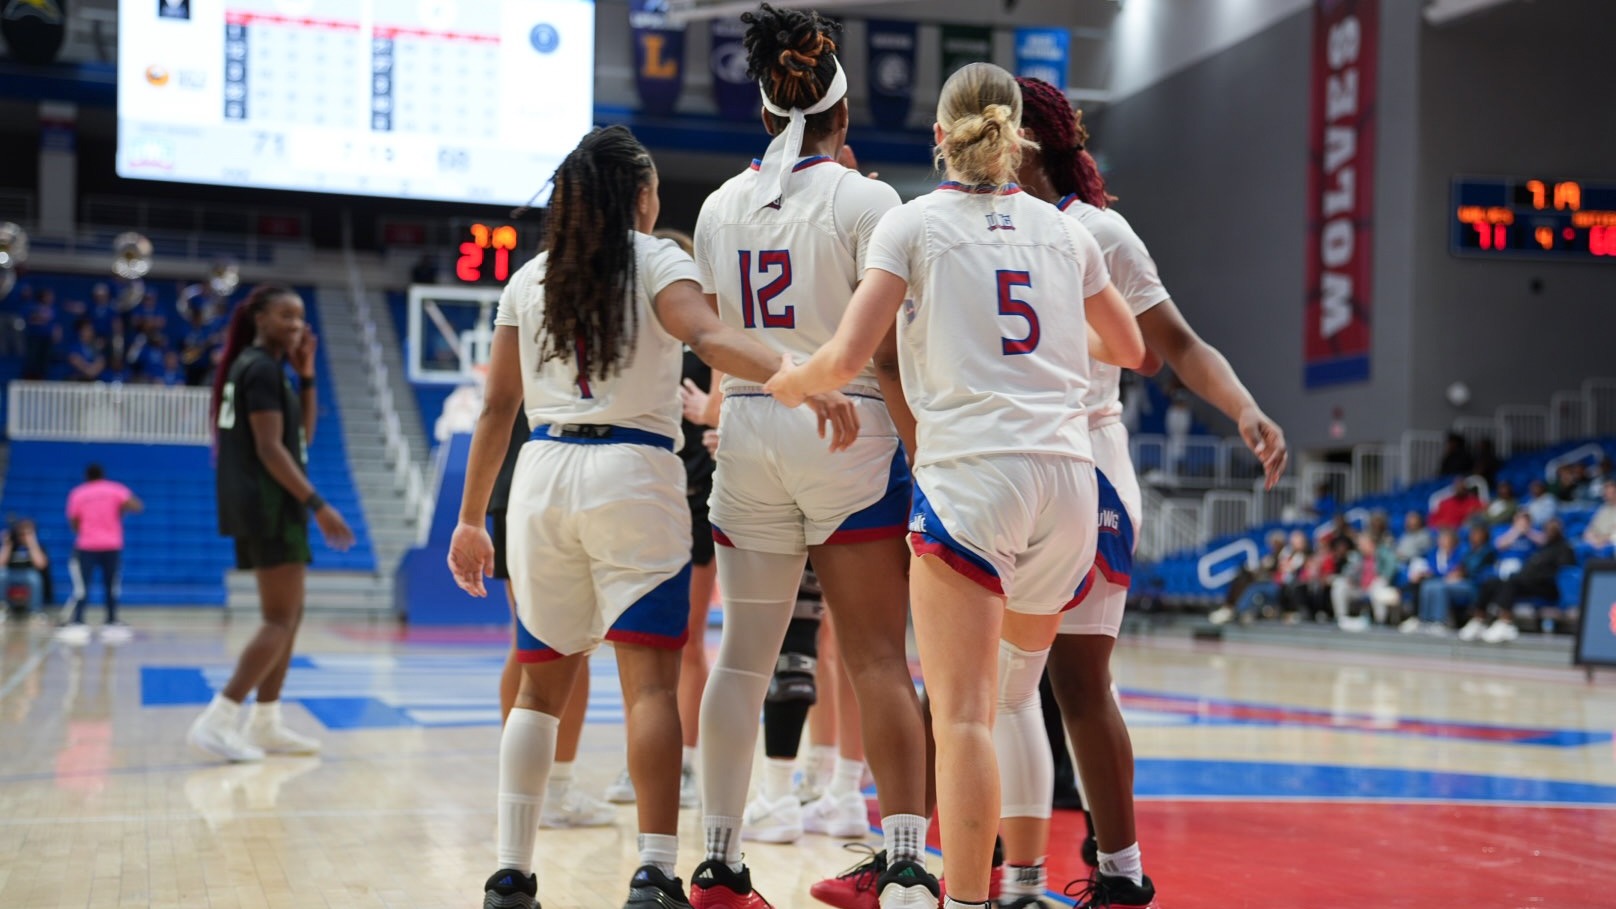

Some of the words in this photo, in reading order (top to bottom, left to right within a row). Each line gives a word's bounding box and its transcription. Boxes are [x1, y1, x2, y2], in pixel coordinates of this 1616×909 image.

[641, 34, 678, 79] L
[1321, 15, 1362, 338] WOLVES
[457, 242, 509, 281] 21
[737, 249, 796, 330] 12
[995, 269, 1041, 356] 5
[1098, 509, 1119, 530] UWG
